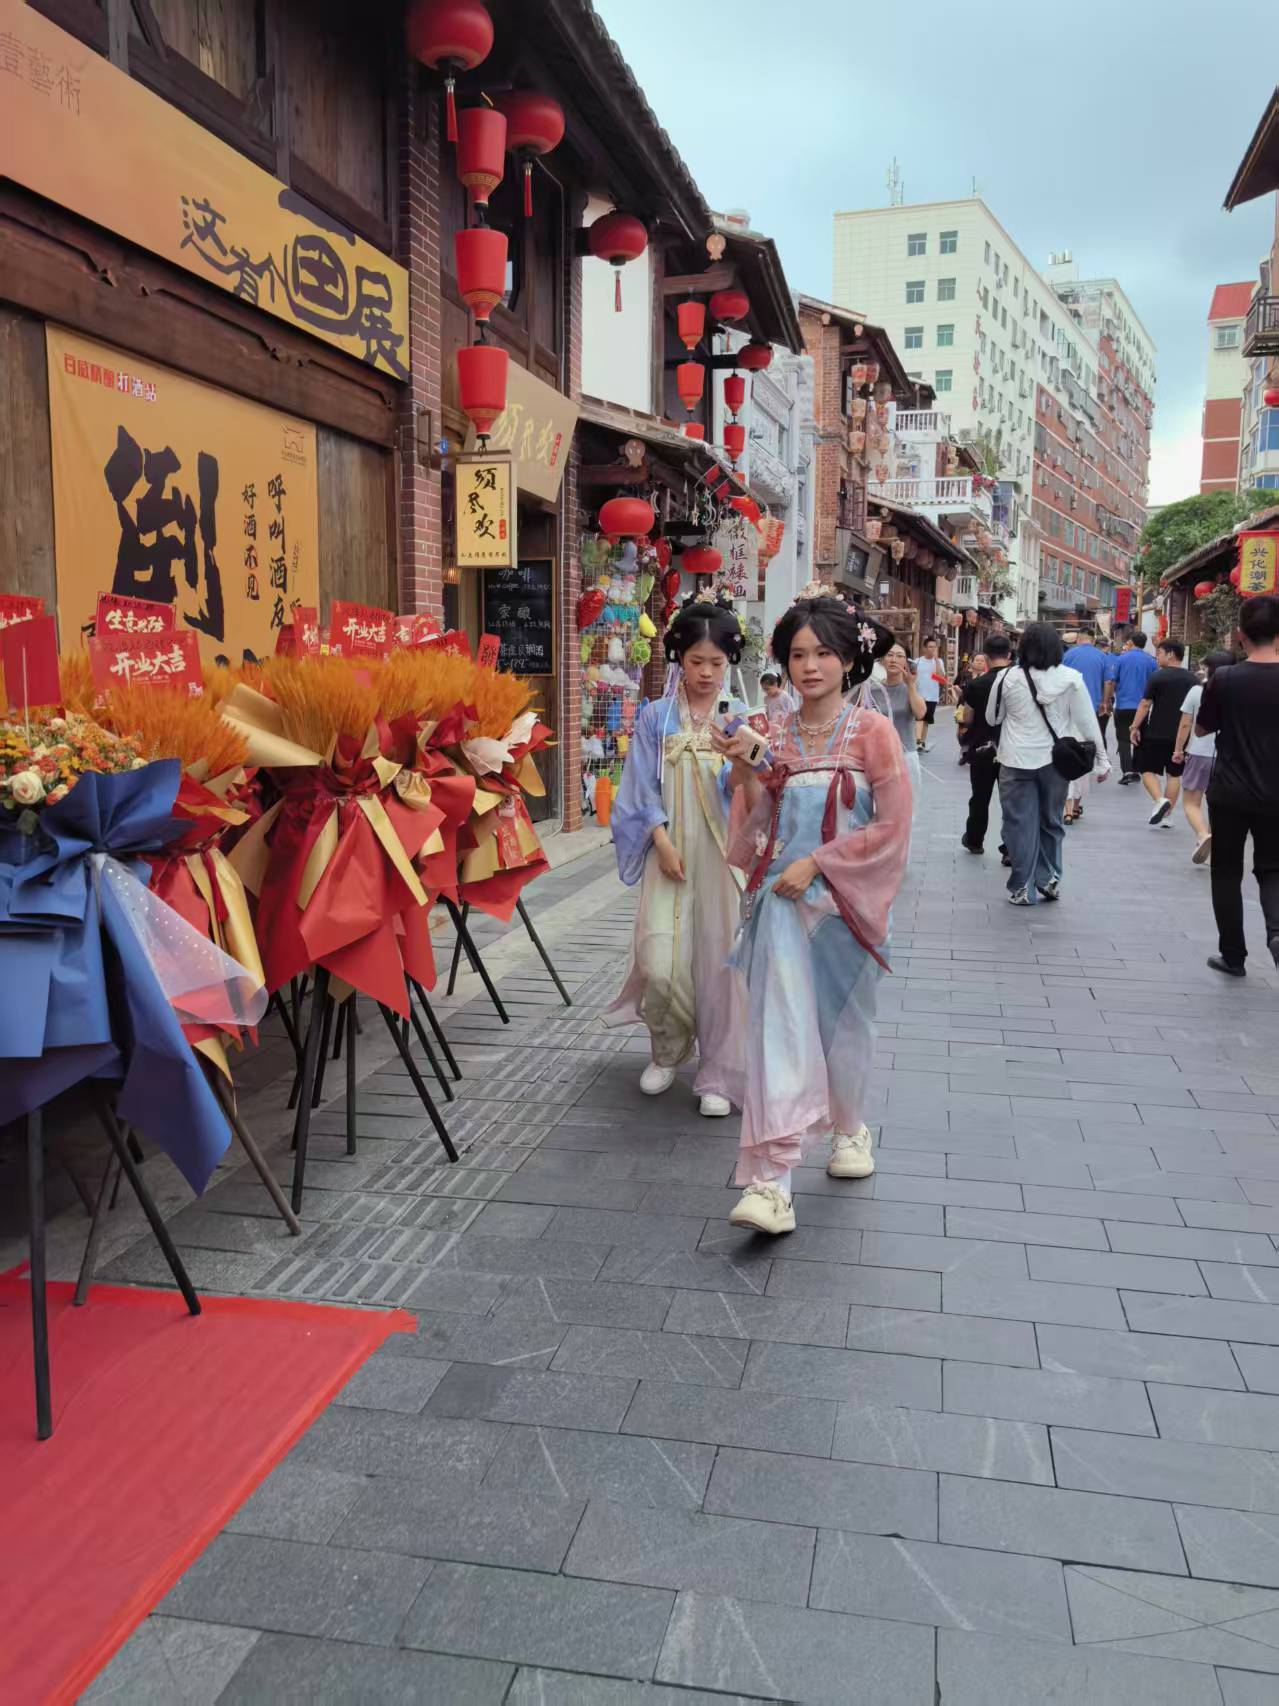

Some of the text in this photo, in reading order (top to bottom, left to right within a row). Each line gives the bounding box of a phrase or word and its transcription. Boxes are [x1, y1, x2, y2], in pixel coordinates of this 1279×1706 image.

[241, 483, 260, 601] 好酒不见
[267, 473, 288, 630] 呼叫酒友
[109, 643, 187, 686] 开业大吉
[342, 617, 386, 652] 开业大吉
